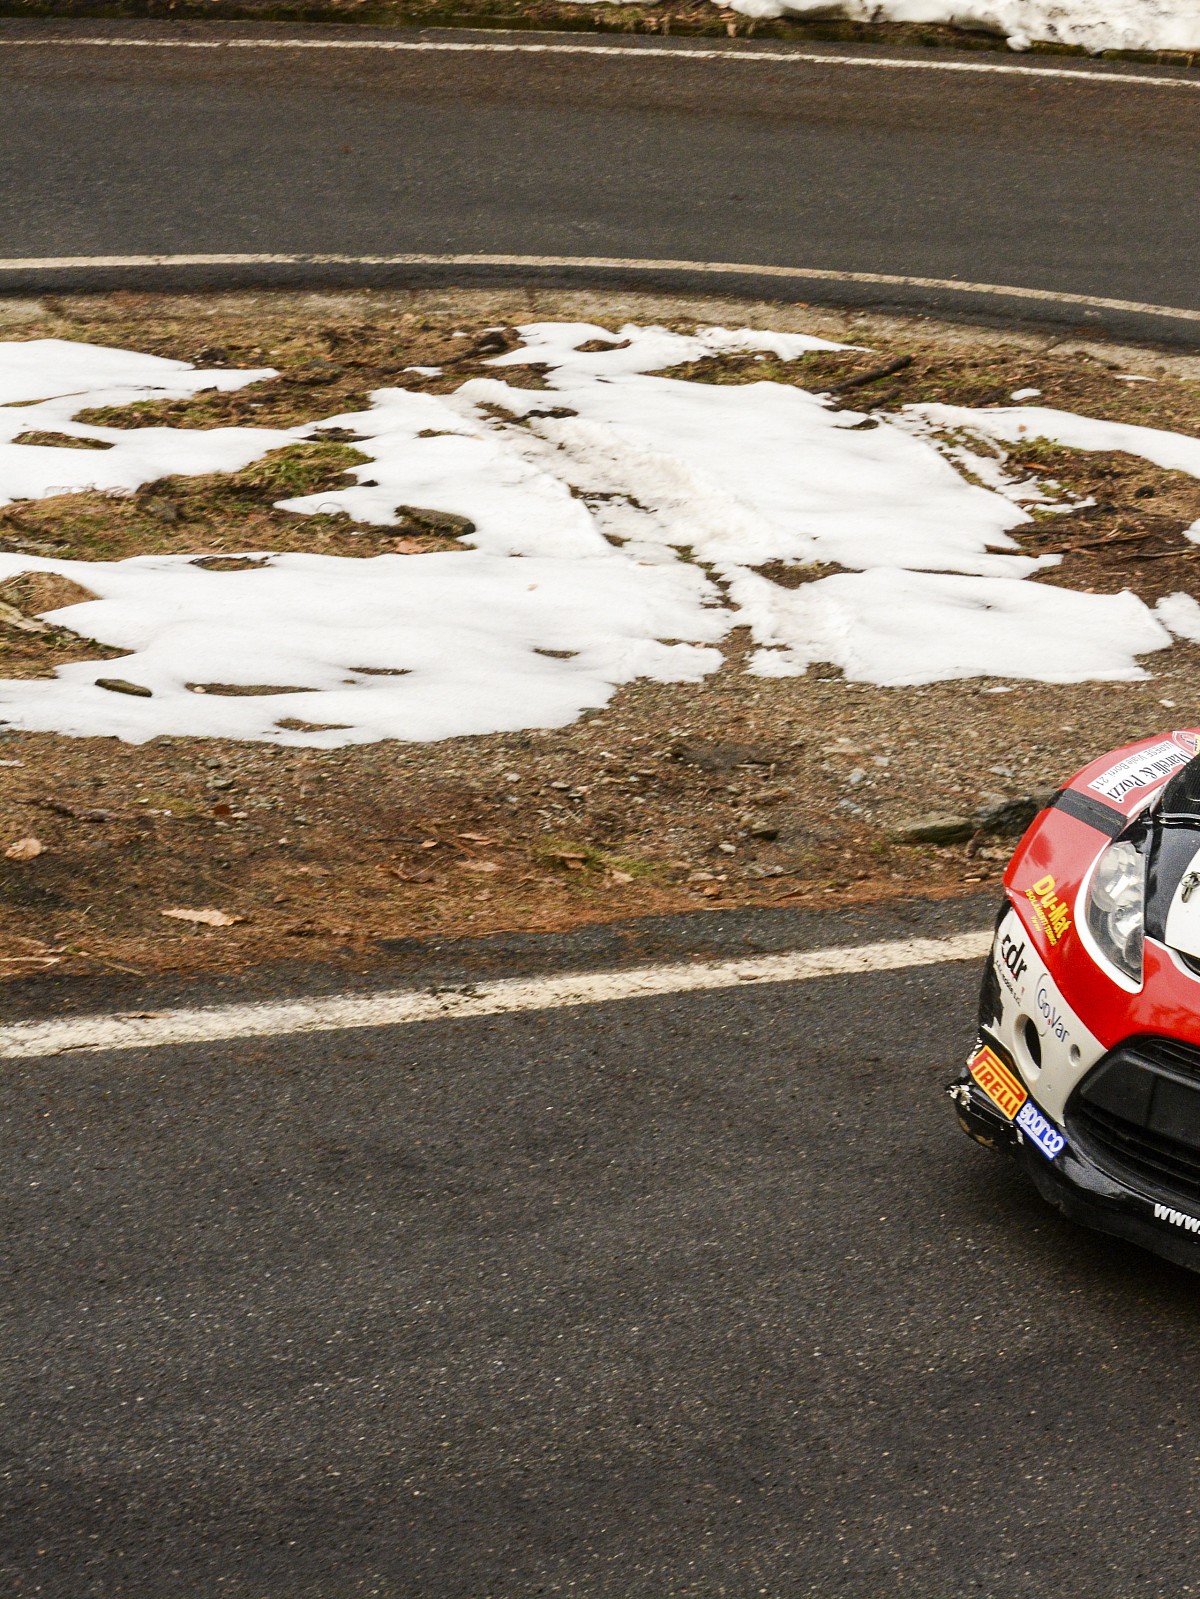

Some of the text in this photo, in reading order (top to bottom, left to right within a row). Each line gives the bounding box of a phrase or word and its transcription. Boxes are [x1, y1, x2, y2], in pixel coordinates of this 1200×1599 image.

[1139, 766, 1158, 780] &
[1033, 874, 1072, 939] Du-Mat
[968, 1049, 1024, 1116] PIRELLI
[1017, 1102, 1064, 1153] sparco
